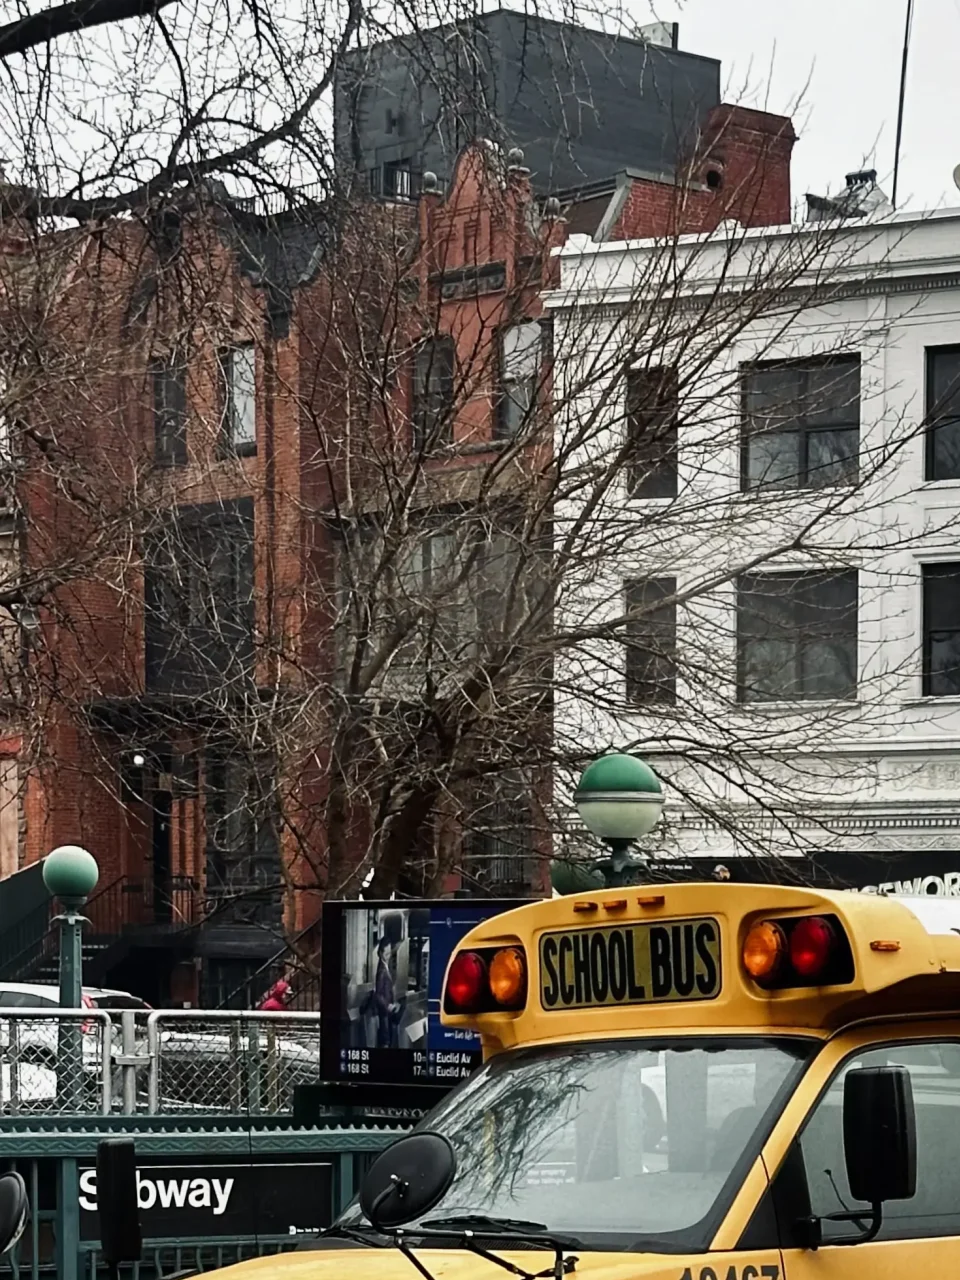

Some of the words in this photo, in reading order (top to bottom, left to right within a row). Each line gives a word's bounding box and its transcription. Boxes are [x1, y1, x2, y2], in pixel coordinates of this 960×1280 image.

[543, 929, 646, 1006] SCHOOL
[650, 922, 717, 998] BUS
[347, 1050, 360, 1060] 168
[361, 1050, 370, 1060] St
[436, 1053, 460, 1063] Euclid
[461, 1053, 471, 1063] Av
[361, 1063, 370, 1074] St
[436, 1066, 460, 1077] Euclid
[461, 1067, 471, 1077] Av
[78, 1169, 234, 1215] Sbway
